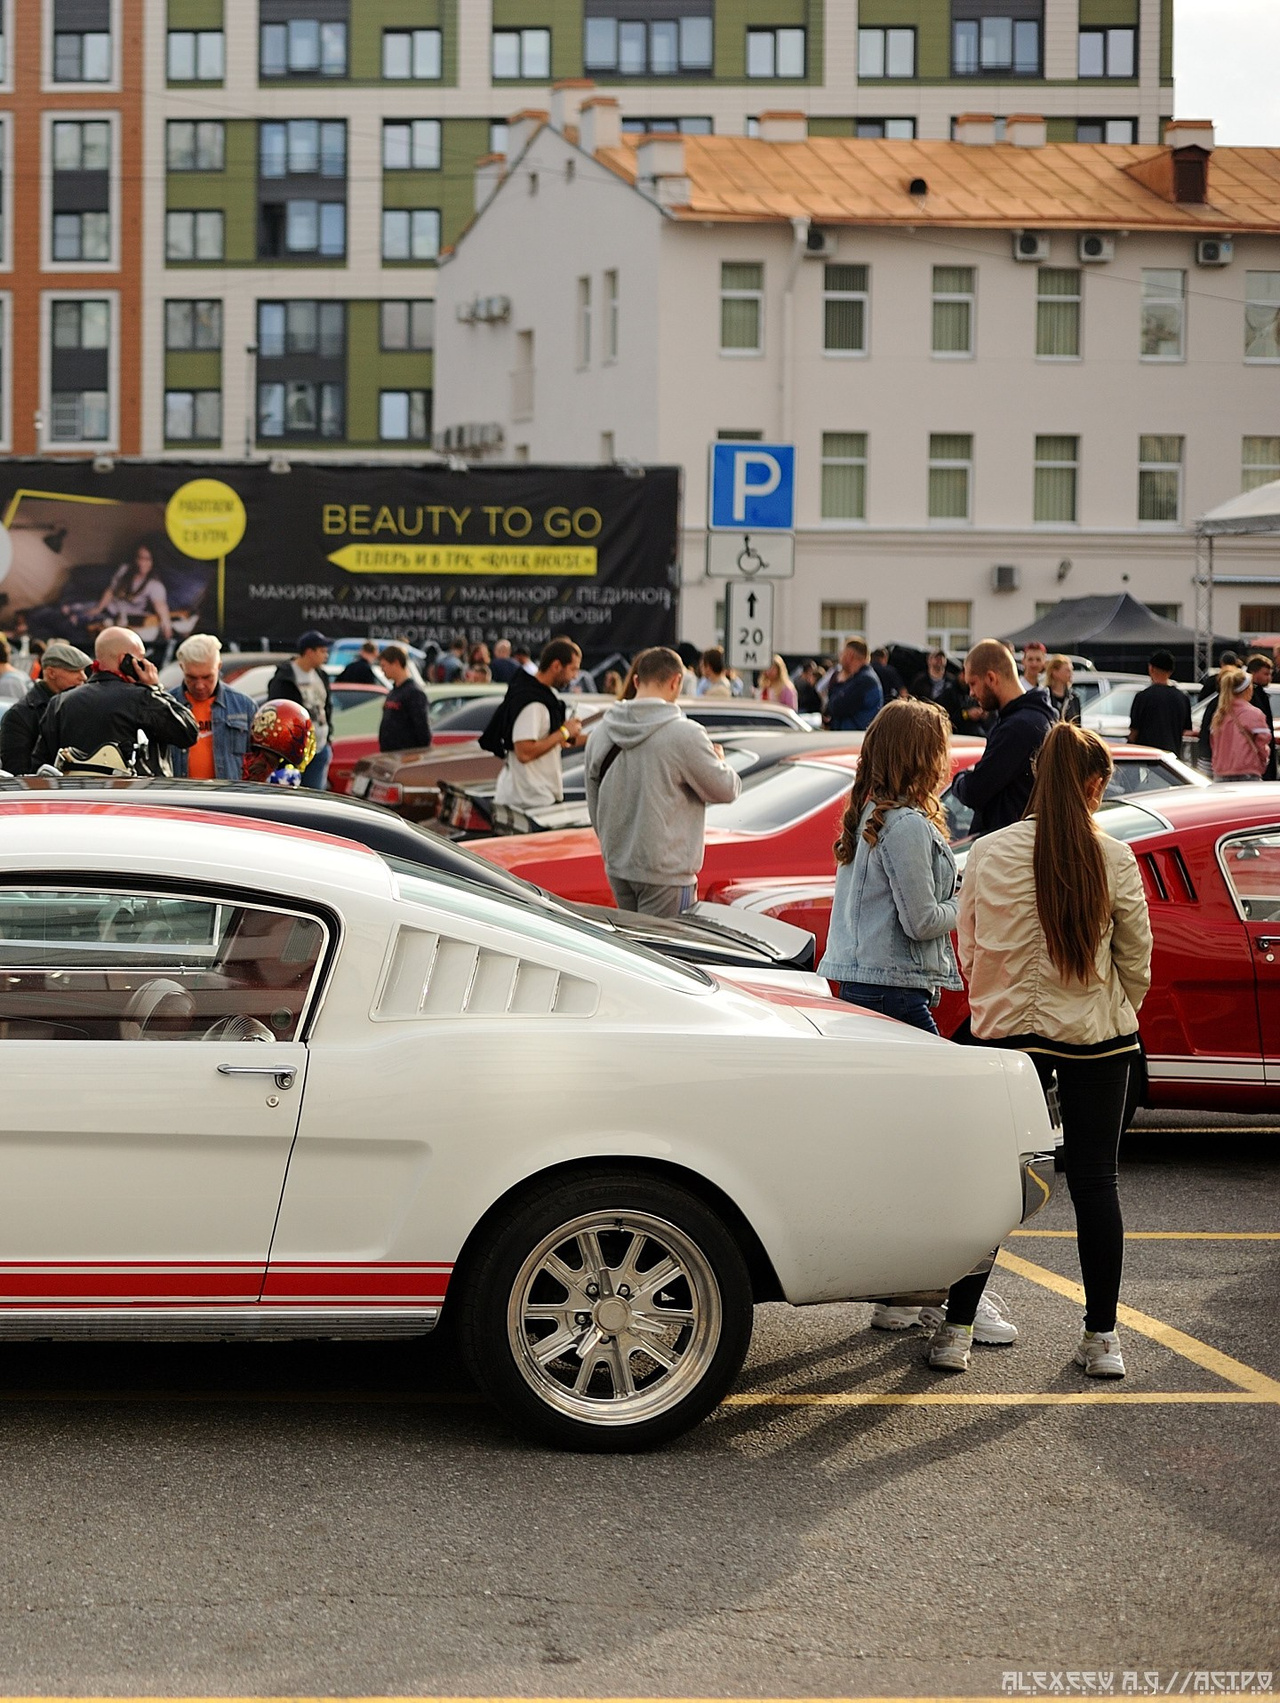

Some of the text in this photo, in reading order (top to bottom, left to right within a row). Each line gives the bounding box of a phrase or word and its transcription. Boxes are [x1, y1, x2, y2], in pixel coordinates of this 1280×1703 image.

[732, 451, 782, 522] P
[322, 504, 603, 539] BEAUTY TO GO
[354, 549, 411, 566] ТЕПЕРЬ
[248, 584, 334, 600] МАКИЯЖ
[353, 585, 441, 602] УКЛАДКИ
[459, 585, 559, 603] МАНИКЮР
[575, 586, 671, 607] ПЕДИКЮР
[302, 604, 448, 623] НАРАЩИВАНИЕ
[451, 605, 529, 624] РЕСНИЦ
[547, 606, 612, 625] БРОВИ
[502, 626, 551, 643] РУКИ
[739, 627, 764, 645] 20
[744, 652, 757, 663] М
